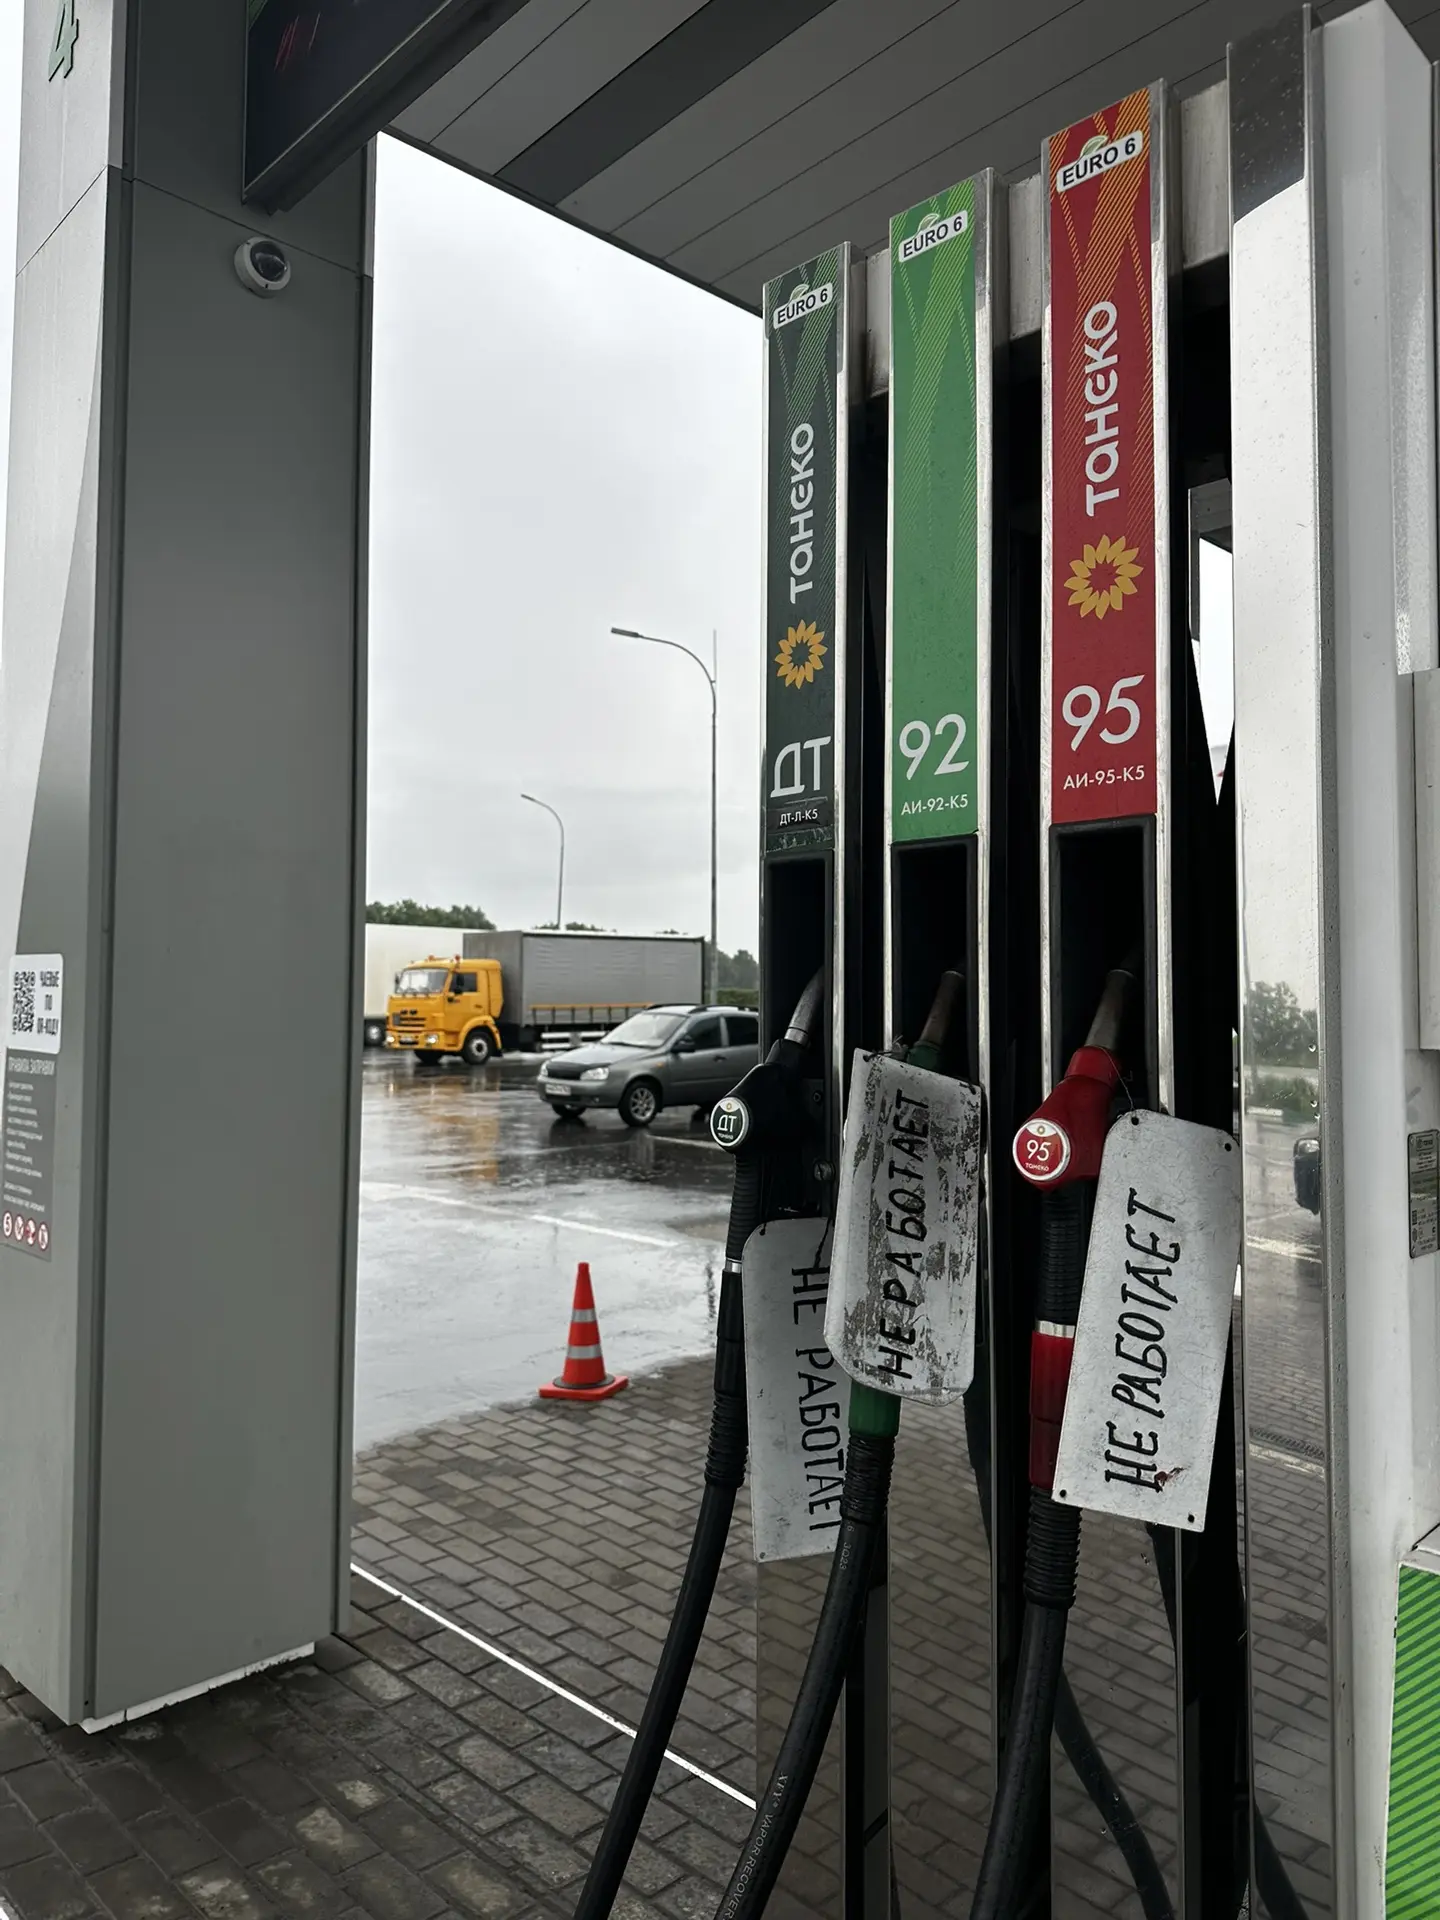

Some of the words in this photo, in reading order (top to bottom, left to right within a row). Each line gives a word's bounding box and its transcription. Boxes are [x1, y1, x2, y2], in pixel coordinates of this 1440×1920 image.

[48, 0, 79, 82] 4
[1061, 147, 1118, 186] EURO
[1124, 137, 1136, 156] 6
[903, 225, 950, 258] EURO
[953, 216, 963, 232] 6
[777, 298, 817, 325] EURO
[820, 288, 829, 303] 6
[1062, 674, 1145, 752] 95
[770, 736, 832, 798] ДТ
[899, 713, 969, 781] 92
[901, 794, 969, 816] АИ-92-К5
[1063, 765, 1145, 790] АИ-95-К5
[780, 808, 818, 826] ДТ-Л-К5
[717, 1114, 738, 1133] ДТ
[1026, 1139, 1052, 1161] 95
[882, 1088, 929, 1307] РАБОТАЕТ
[791, 1267, 830, 1325] НЕ
[1111, 1187, 1181, 1419] РАБОТАЕТ
[877, 1318, 917, 1380] НЕ
[1104, 1420, 1164, 1493] НЕ
[751, 1813, 774, 1856] VAPOR
[723, 1855, 757, 1920] RECOVER
